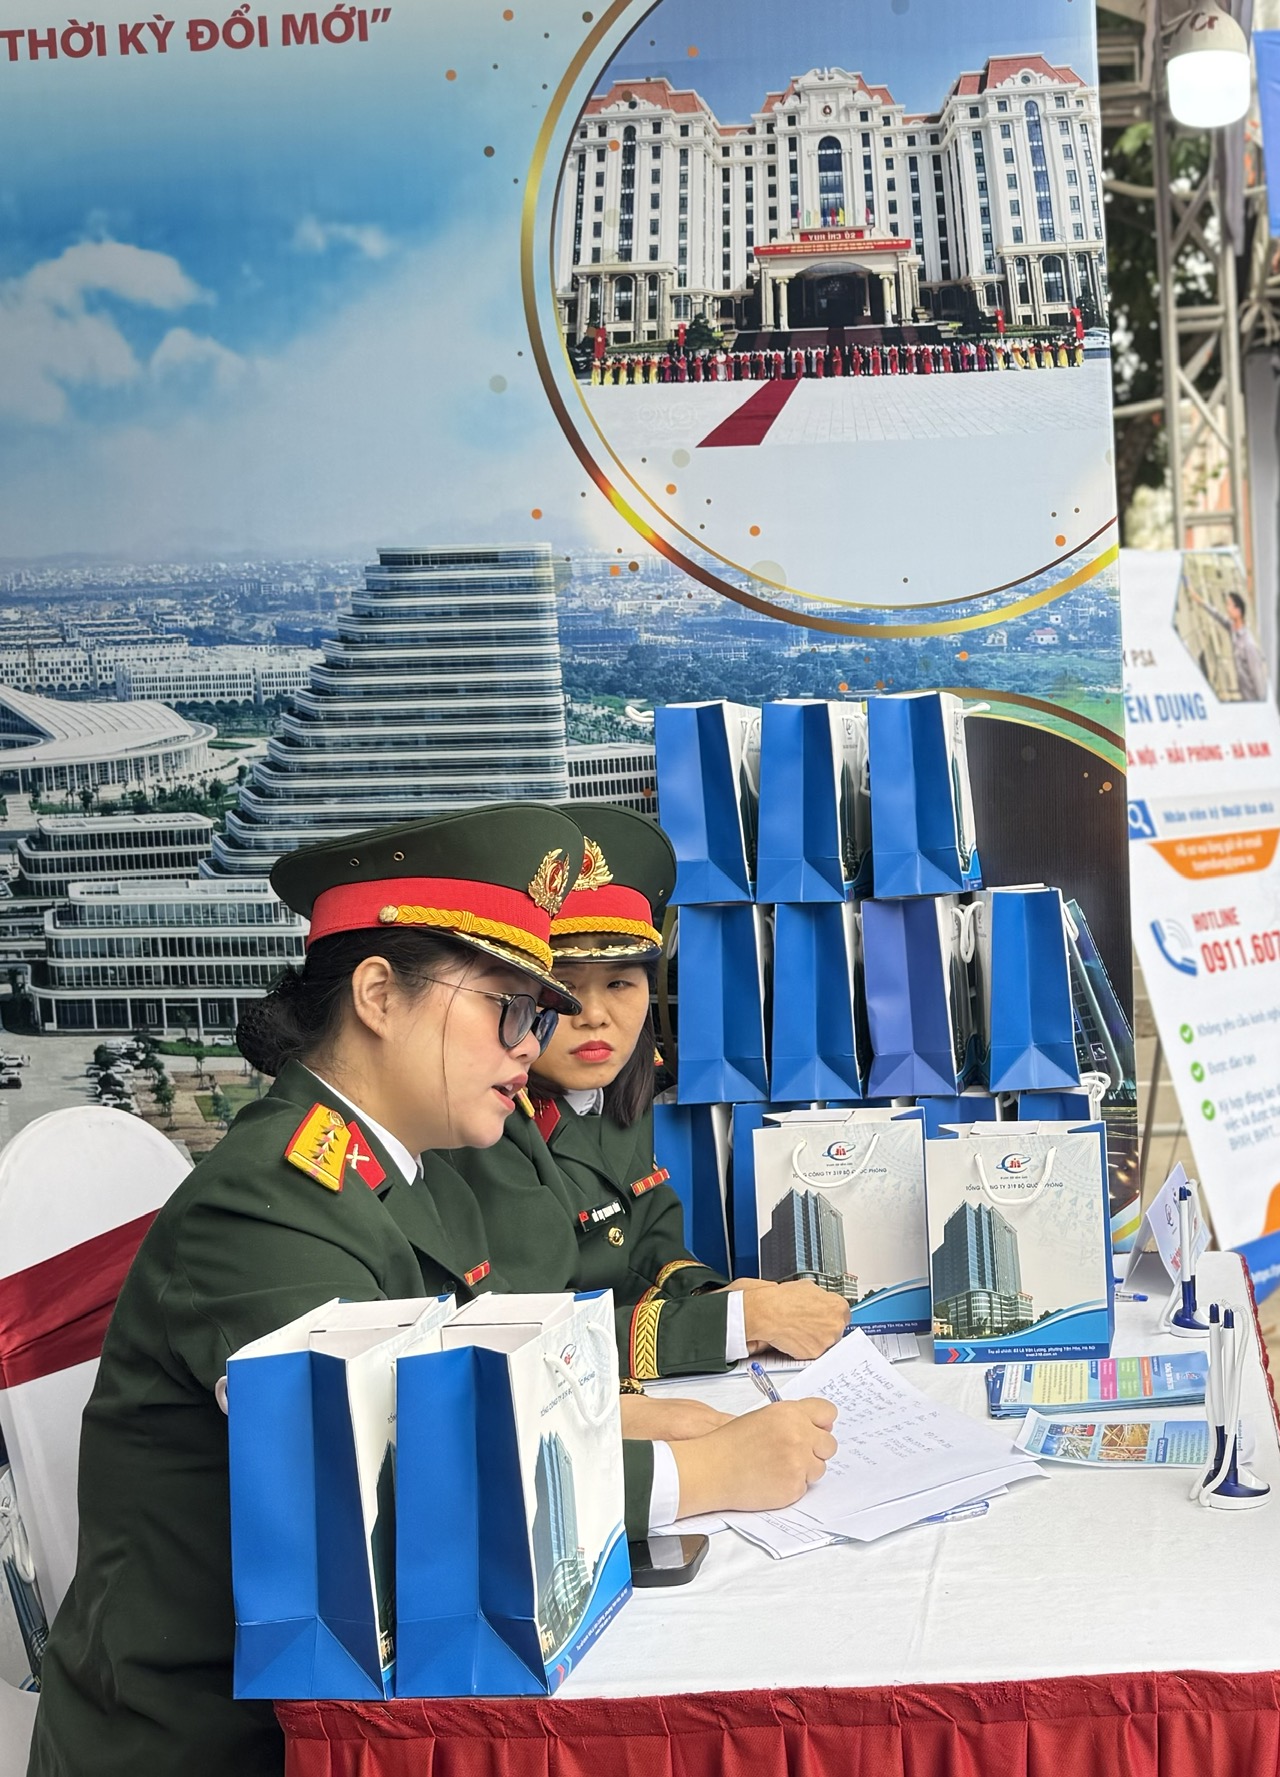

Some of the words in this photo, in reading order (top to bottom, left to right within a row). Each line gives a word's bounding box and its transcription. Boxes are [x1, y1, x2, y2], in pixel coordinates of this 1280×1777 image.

[0, 19, 107, 61] THỜI
[118, 15, 175, 55] KỲ
[186, 3, 268, 52] ĐỔI
[1155, 693, 1208, 729] DỤNG
[1192, 906, 1240, 933] HOTLINE
